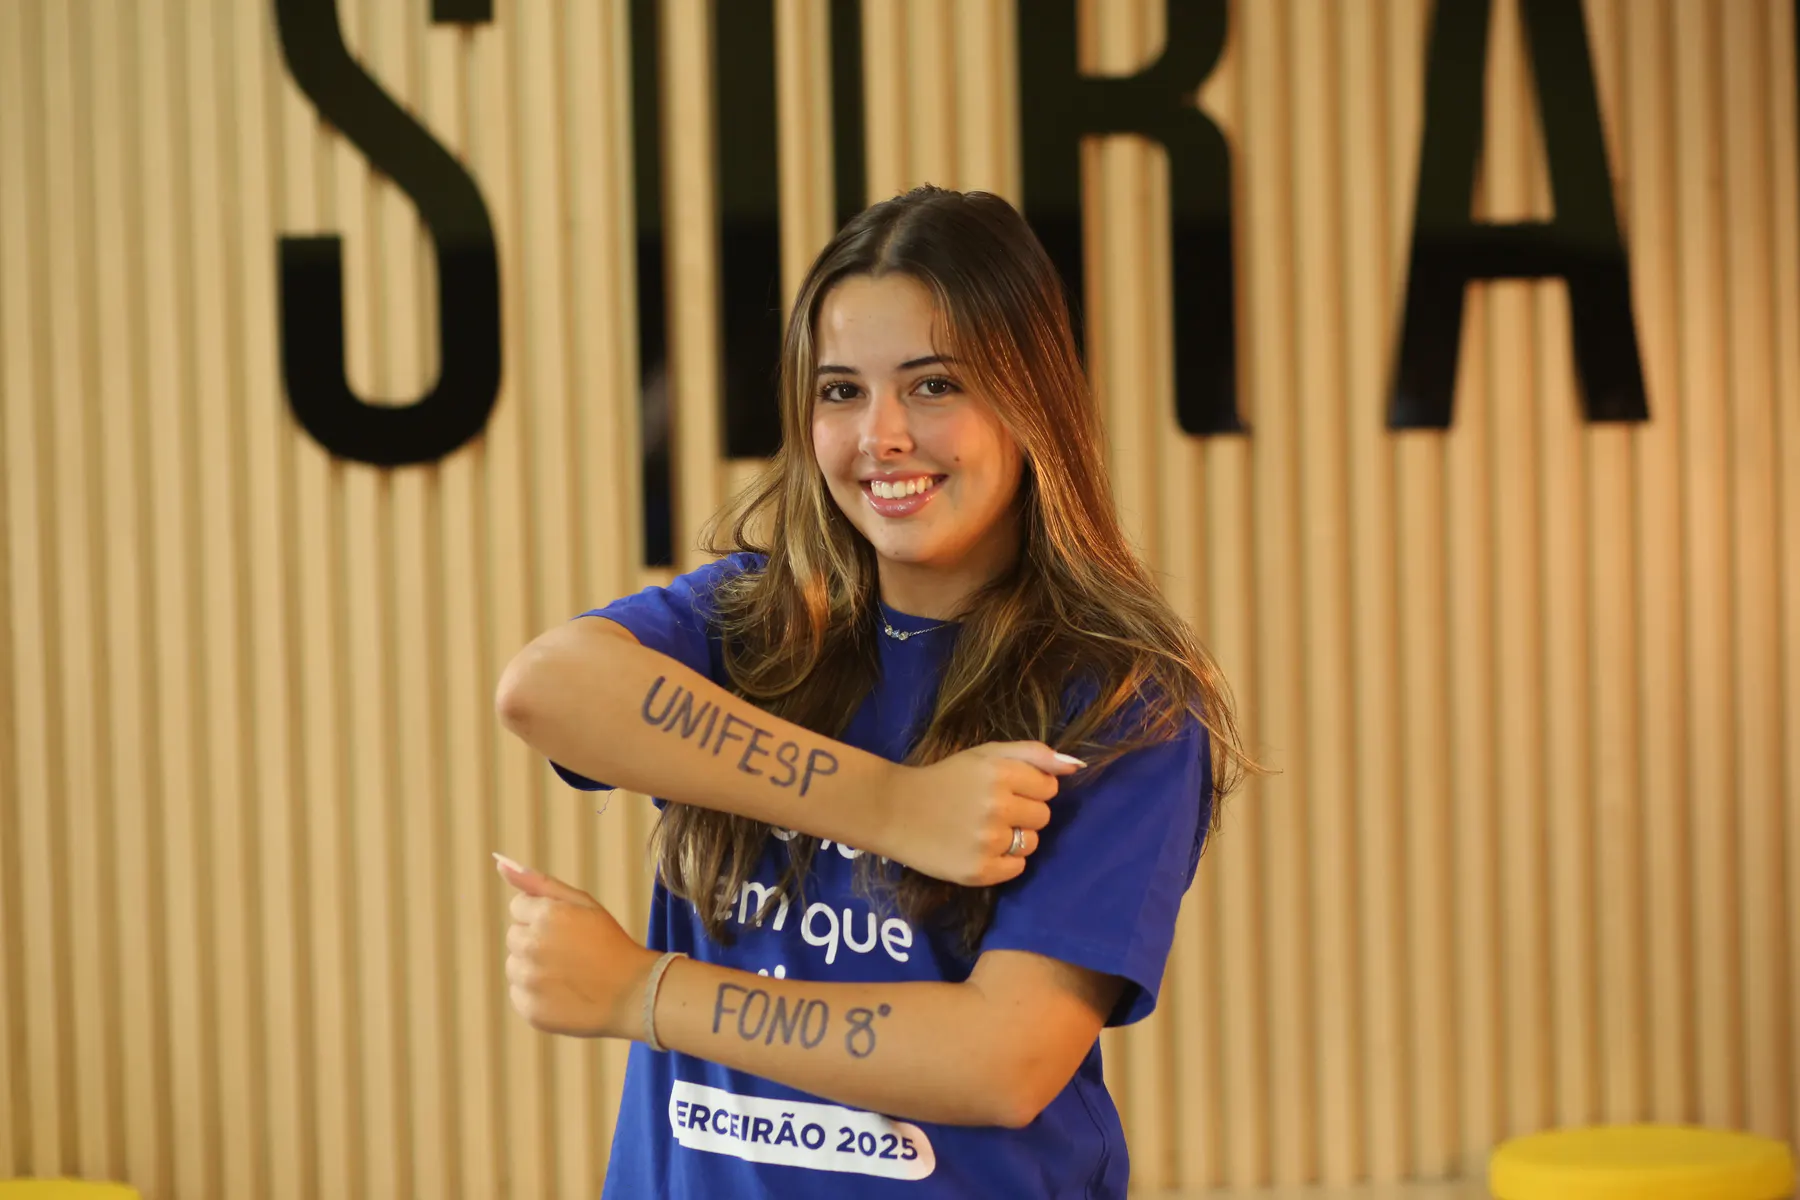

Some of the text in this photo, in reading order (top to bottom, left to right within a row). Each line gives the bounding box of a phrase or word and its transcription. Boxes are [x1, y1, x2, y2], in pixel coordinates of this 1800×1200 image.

[641, 675, 839, 797] UNIFESP
[800, 902, 913, 965] que
[712, 982, 829, 1049] FONO
[836, 1126, 918, 1161] 2025
